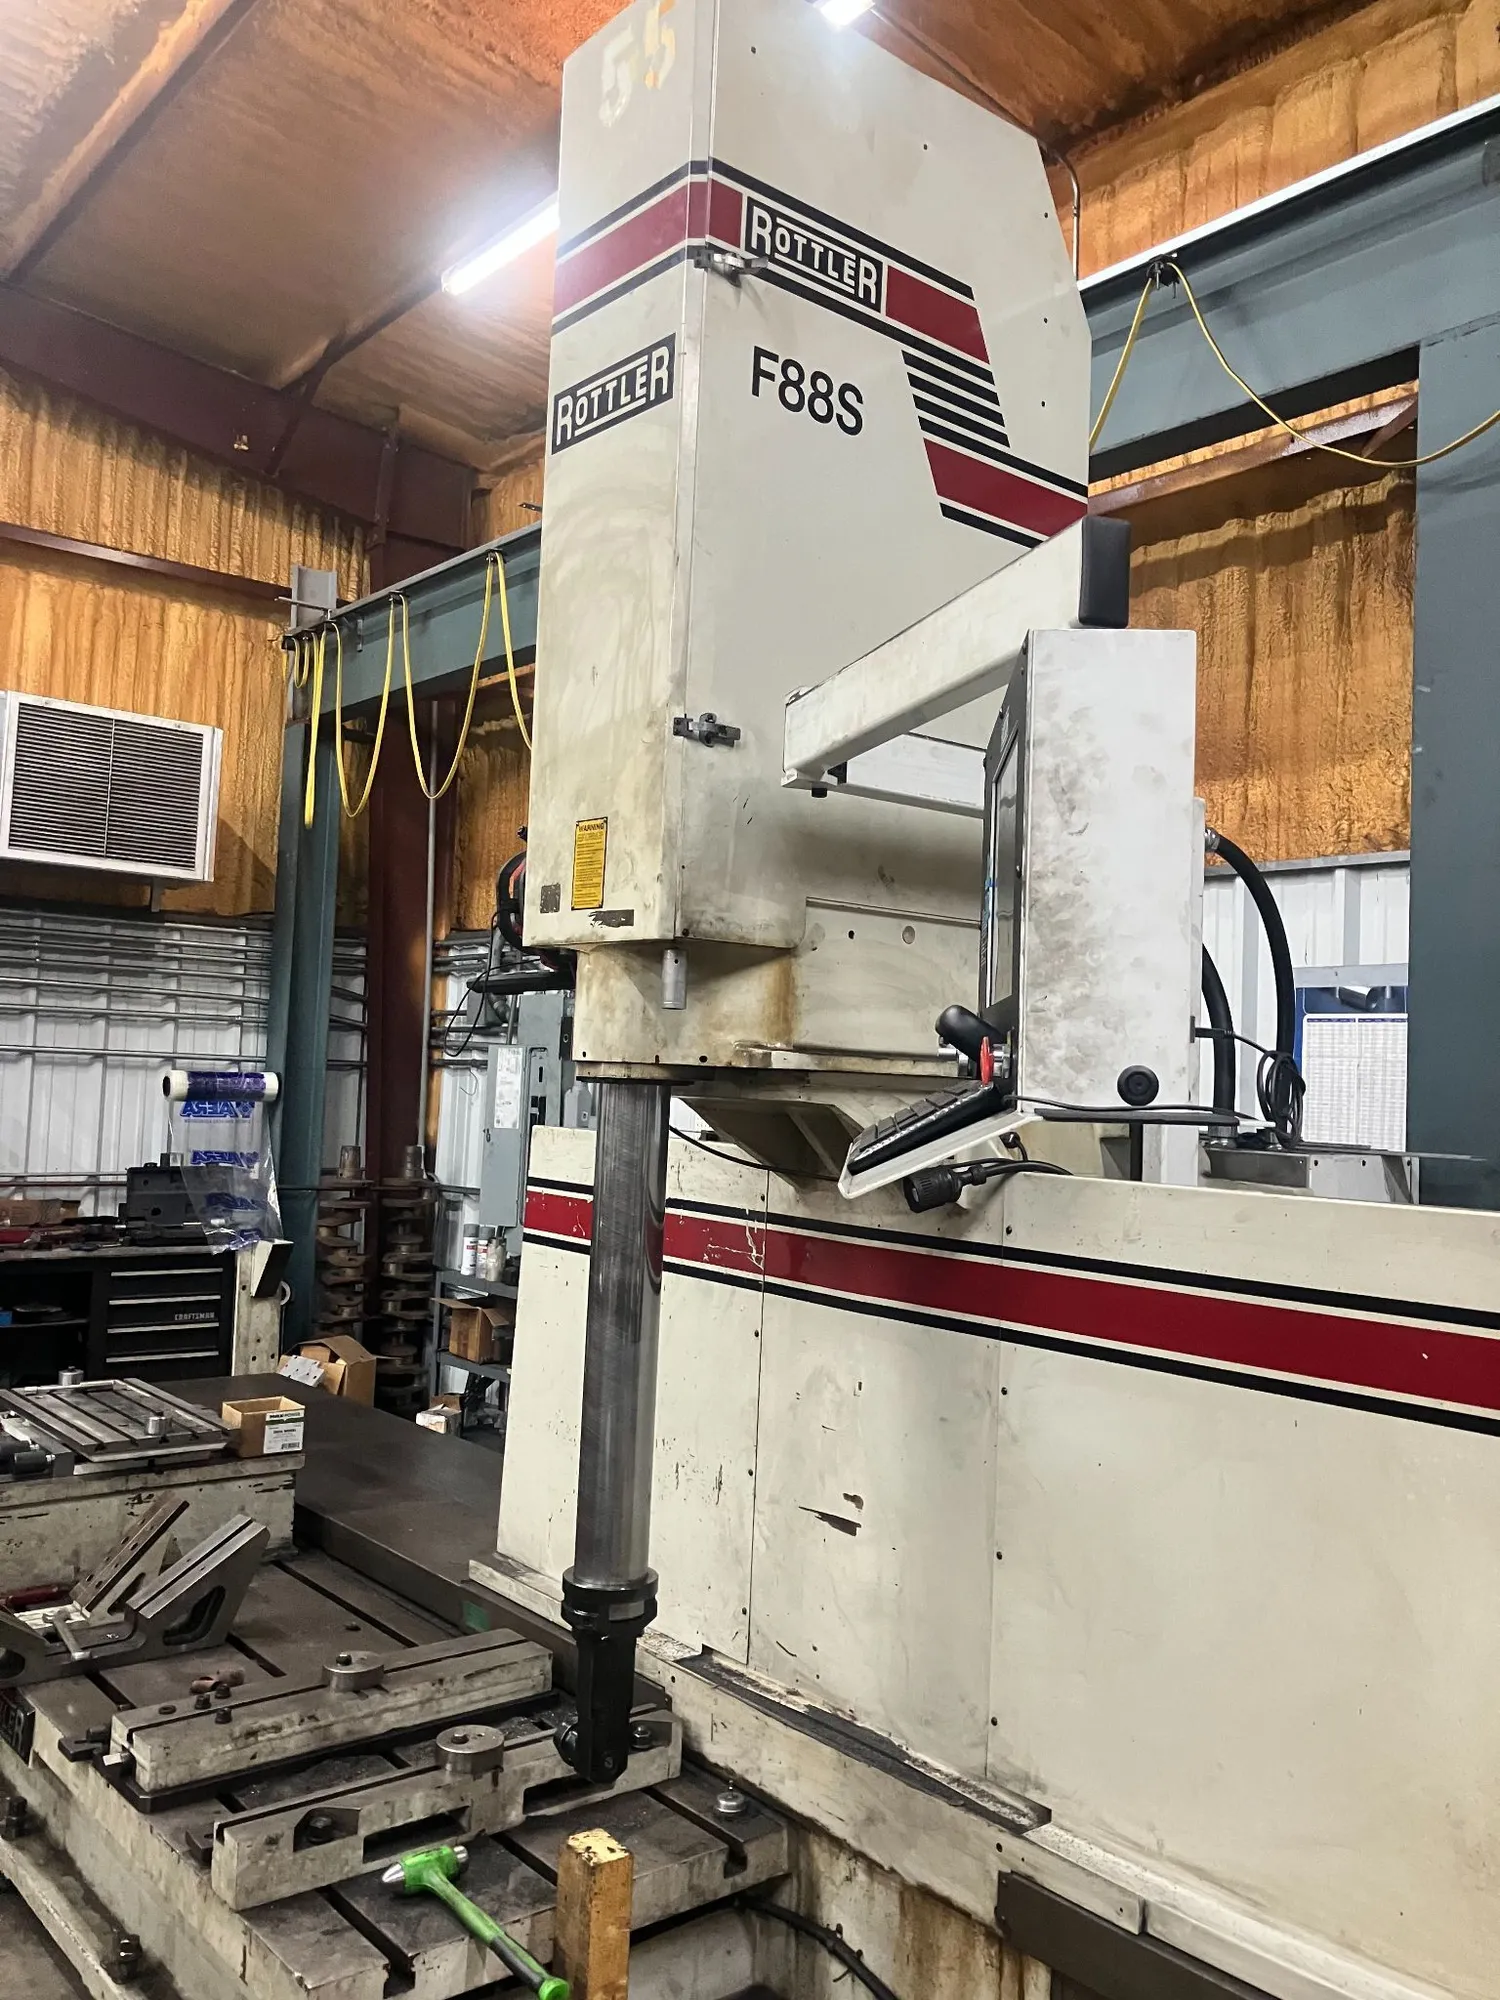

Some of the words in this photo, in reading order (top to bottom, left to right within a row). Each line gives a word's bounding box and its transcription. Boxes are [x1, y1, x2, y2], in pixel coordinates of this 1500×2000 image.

[751, 205, 878, 304] ROTTLER
[556, 346, 670, 446] ROTTLER
[752, 346, 864, 436] F88S
